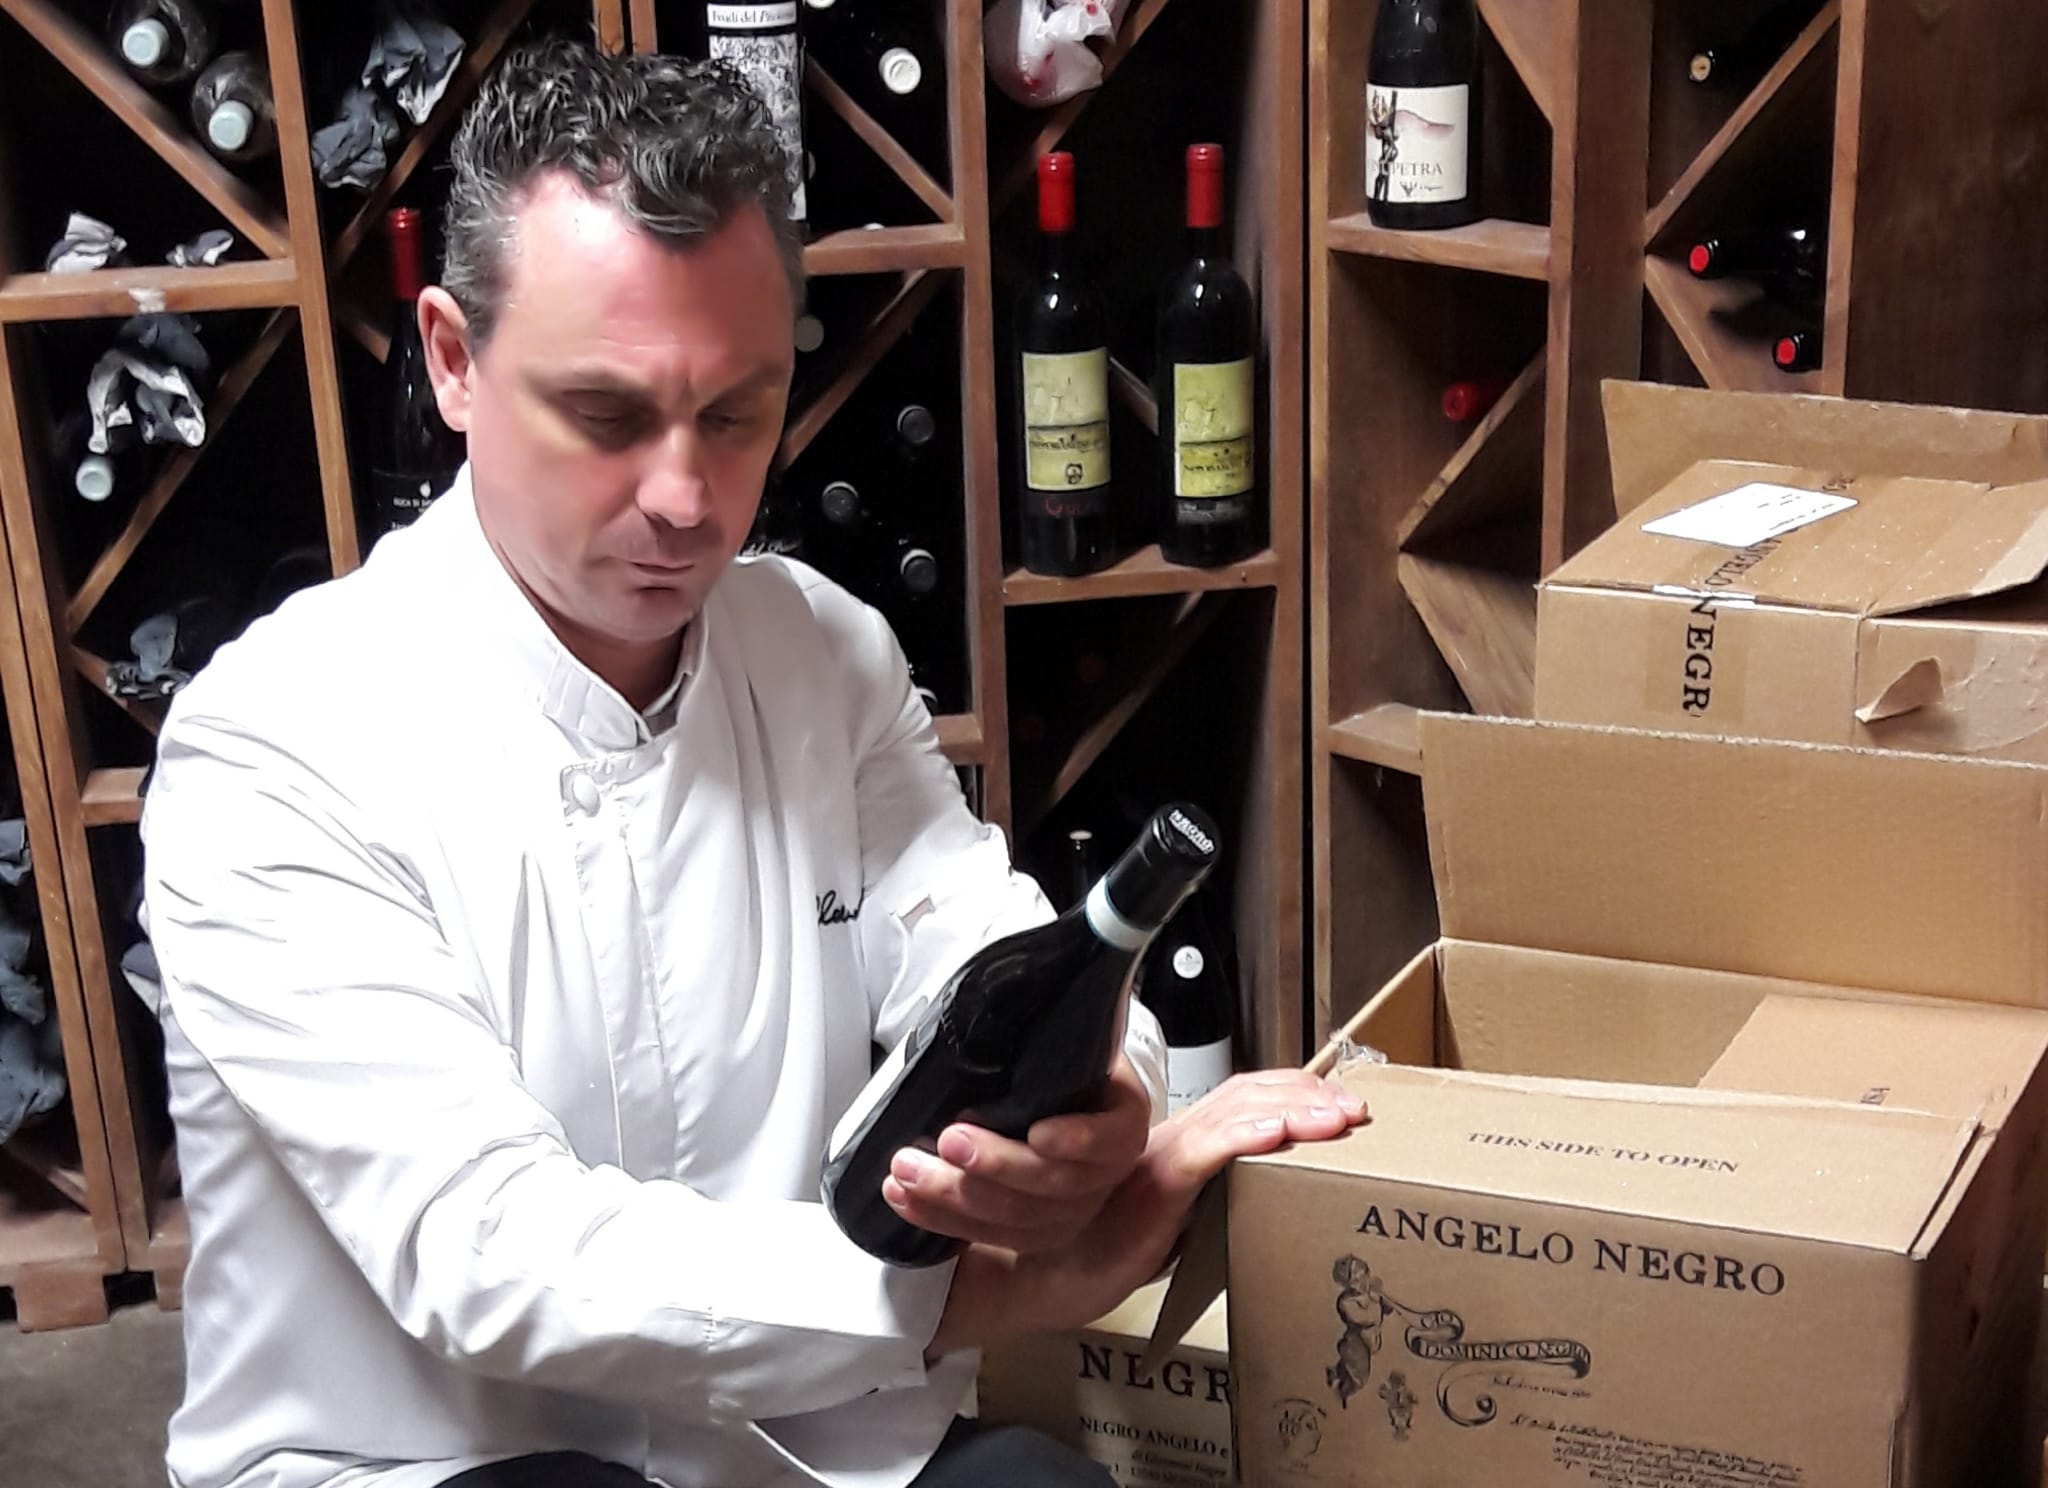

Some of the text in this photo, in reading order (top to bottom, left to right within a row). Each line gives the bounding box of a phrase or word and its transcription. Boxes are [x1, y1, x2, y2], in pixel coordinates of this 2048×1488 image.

[1682, 599, 1717, 718] NEGR
[1467, 1132, 1739, 1173] THIS SIDE TO OPEN
[1357, 1205, 1786, 1296] ANGELO NEGRO
